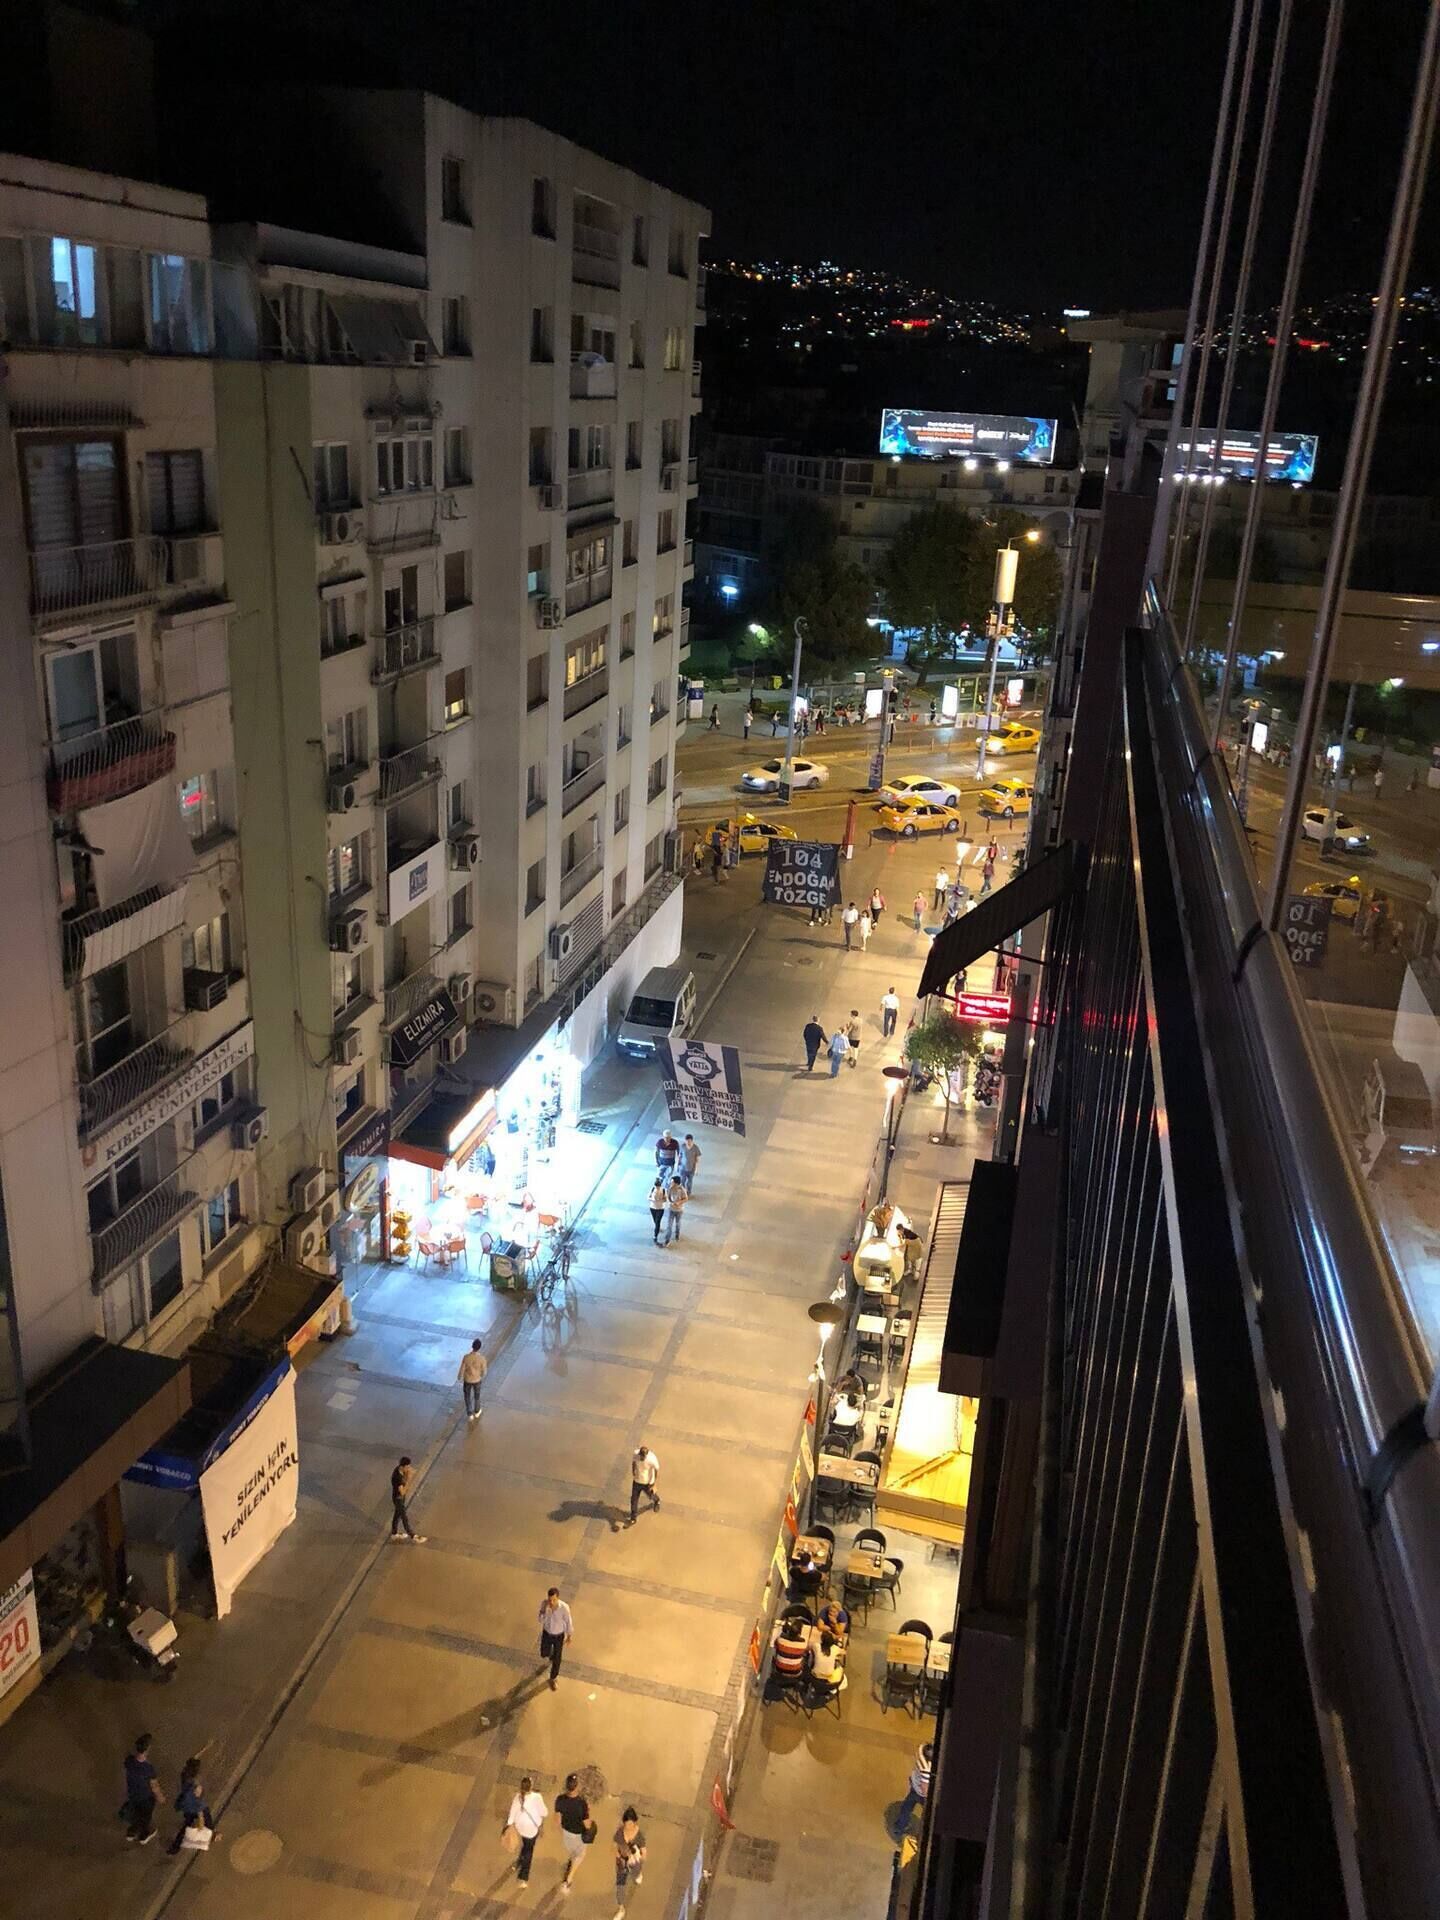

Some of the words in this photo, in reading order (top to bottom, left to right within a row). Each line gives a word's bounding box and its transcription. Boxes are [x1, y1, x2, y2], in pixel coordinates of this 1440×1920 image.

[782, 846, 822, 869] 104
[403, 1001, 445, 1041] ELIZMIRA
[106, 1116, 156, 1161] KIBRIS
